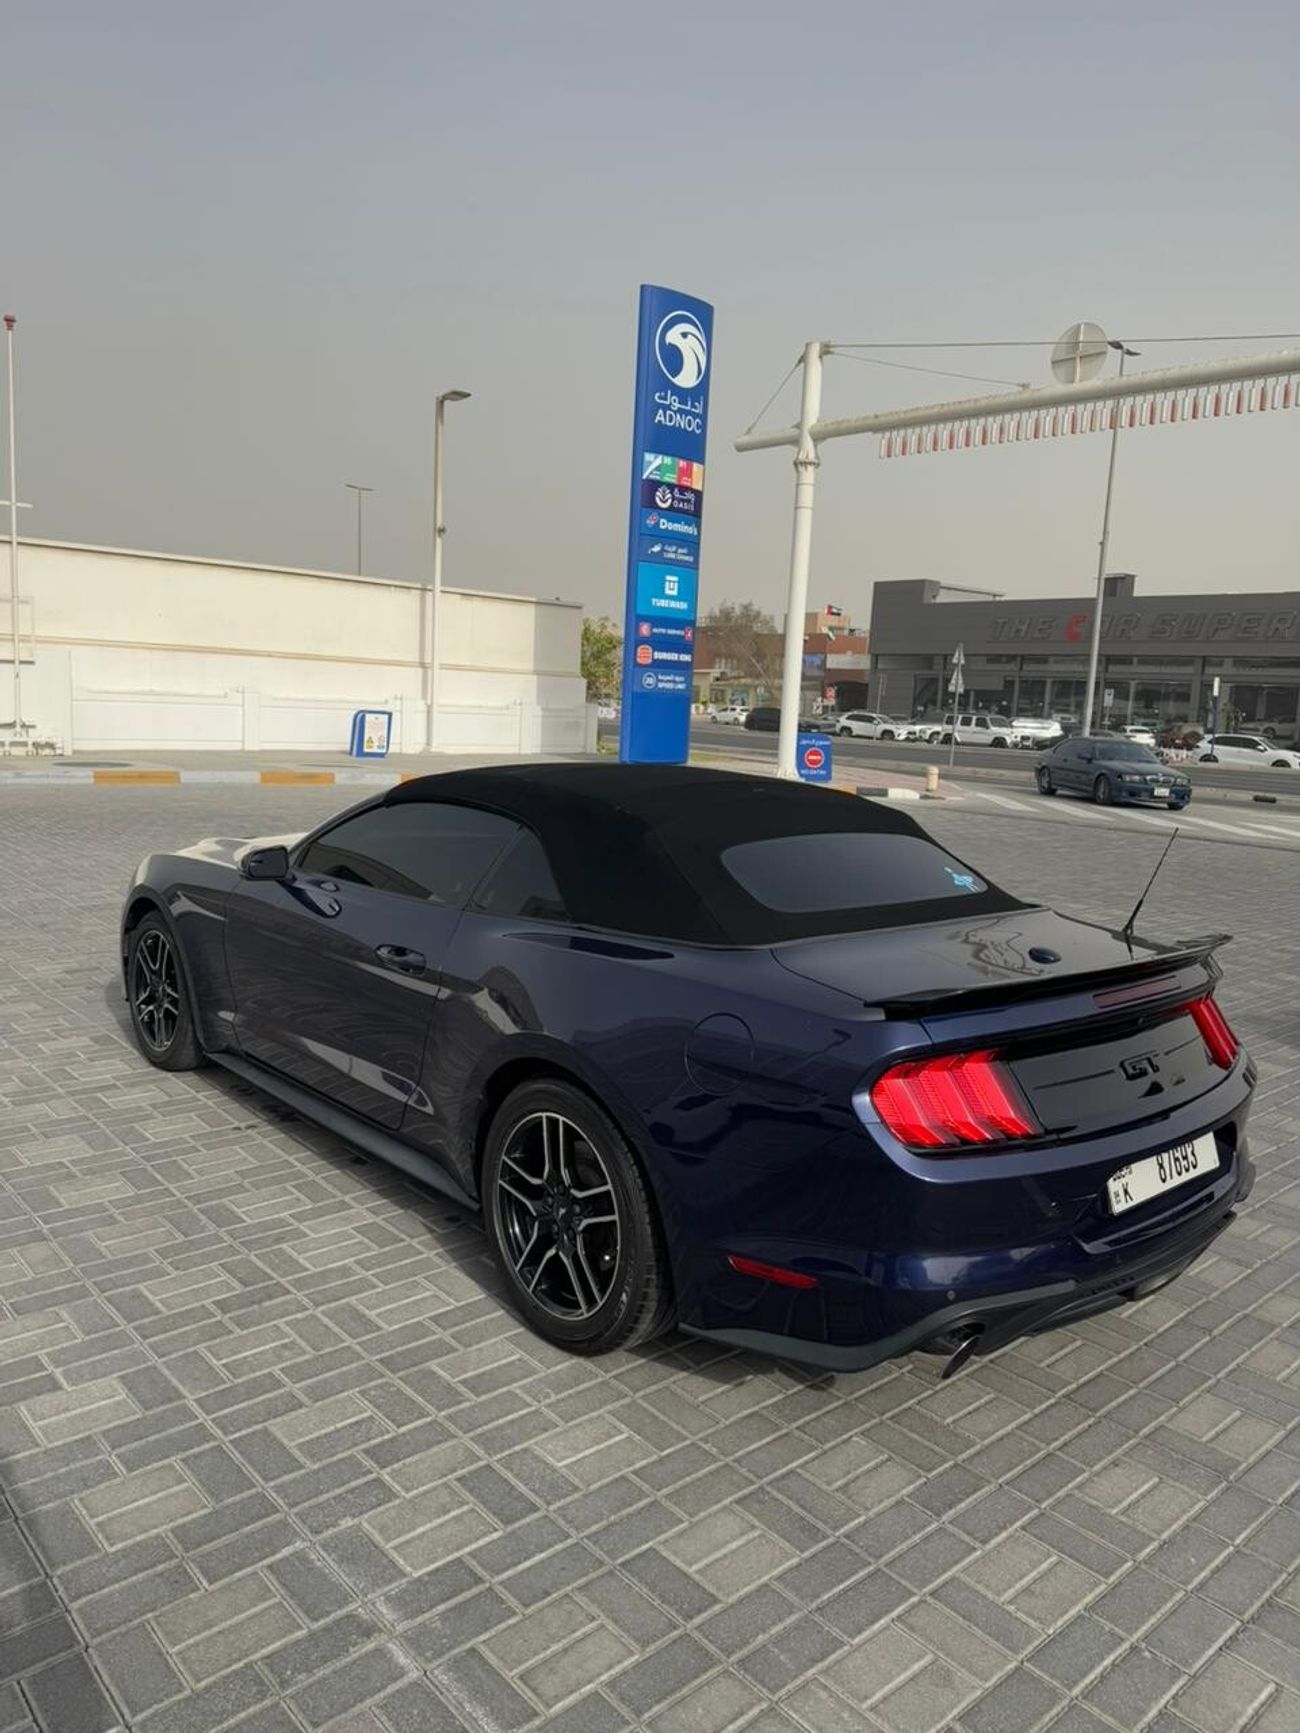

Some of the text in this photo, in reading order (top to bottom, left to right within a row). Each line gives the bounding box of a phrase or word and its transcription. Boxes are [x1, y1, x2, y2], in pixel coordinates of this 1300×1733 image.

[654, 408, 702, 434] ADNOC
[673, 500, 695, 511] OASIS
[659, 518, 698, 536] Domino's
[994, 616, 1055, 640] THE
[653, 651, 678, 661] BURGER
[1119, 1050, 1160, 1081] GT
[1156, 1142, 1198, 1183] 87693
[1121, 1180, 1134, 1204] K
